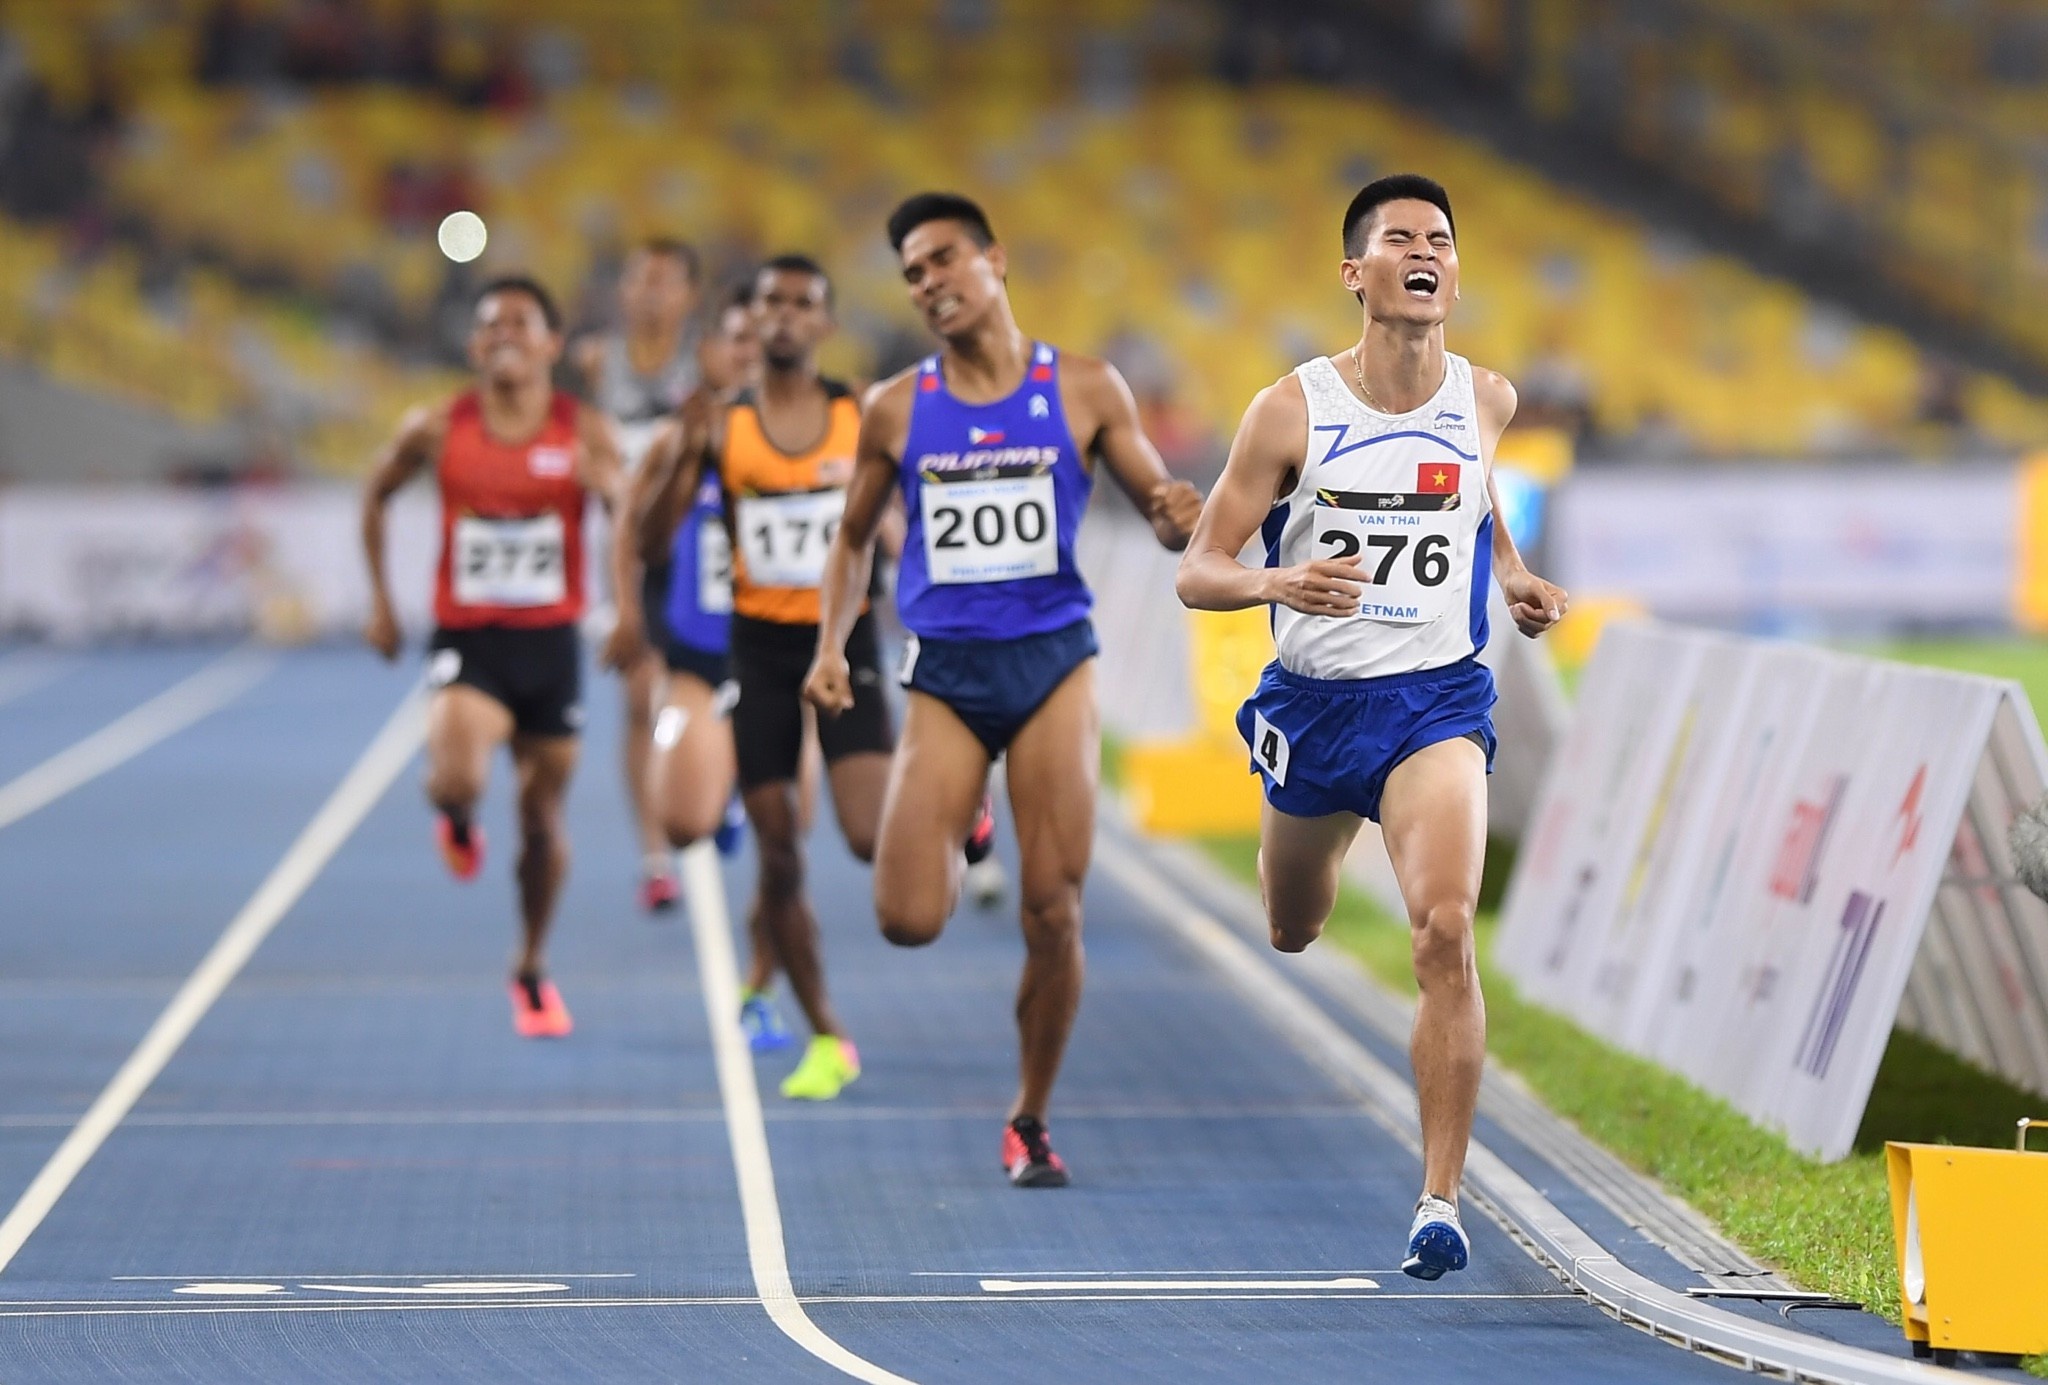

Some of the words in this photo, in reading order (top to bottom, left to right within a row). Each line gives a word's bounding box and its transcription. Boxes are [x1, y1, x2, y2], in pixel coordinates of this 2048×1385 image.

[932, 501, 1047, 549] 200
[1358, 514, 1386, 525] VAN
[1389, 515, 1421, 526] THAI
[1318, 529, 1451, 587] 276
[1361, 603, 1419, 618] ETNAM
[1260, 729, 1279, 773] 4
